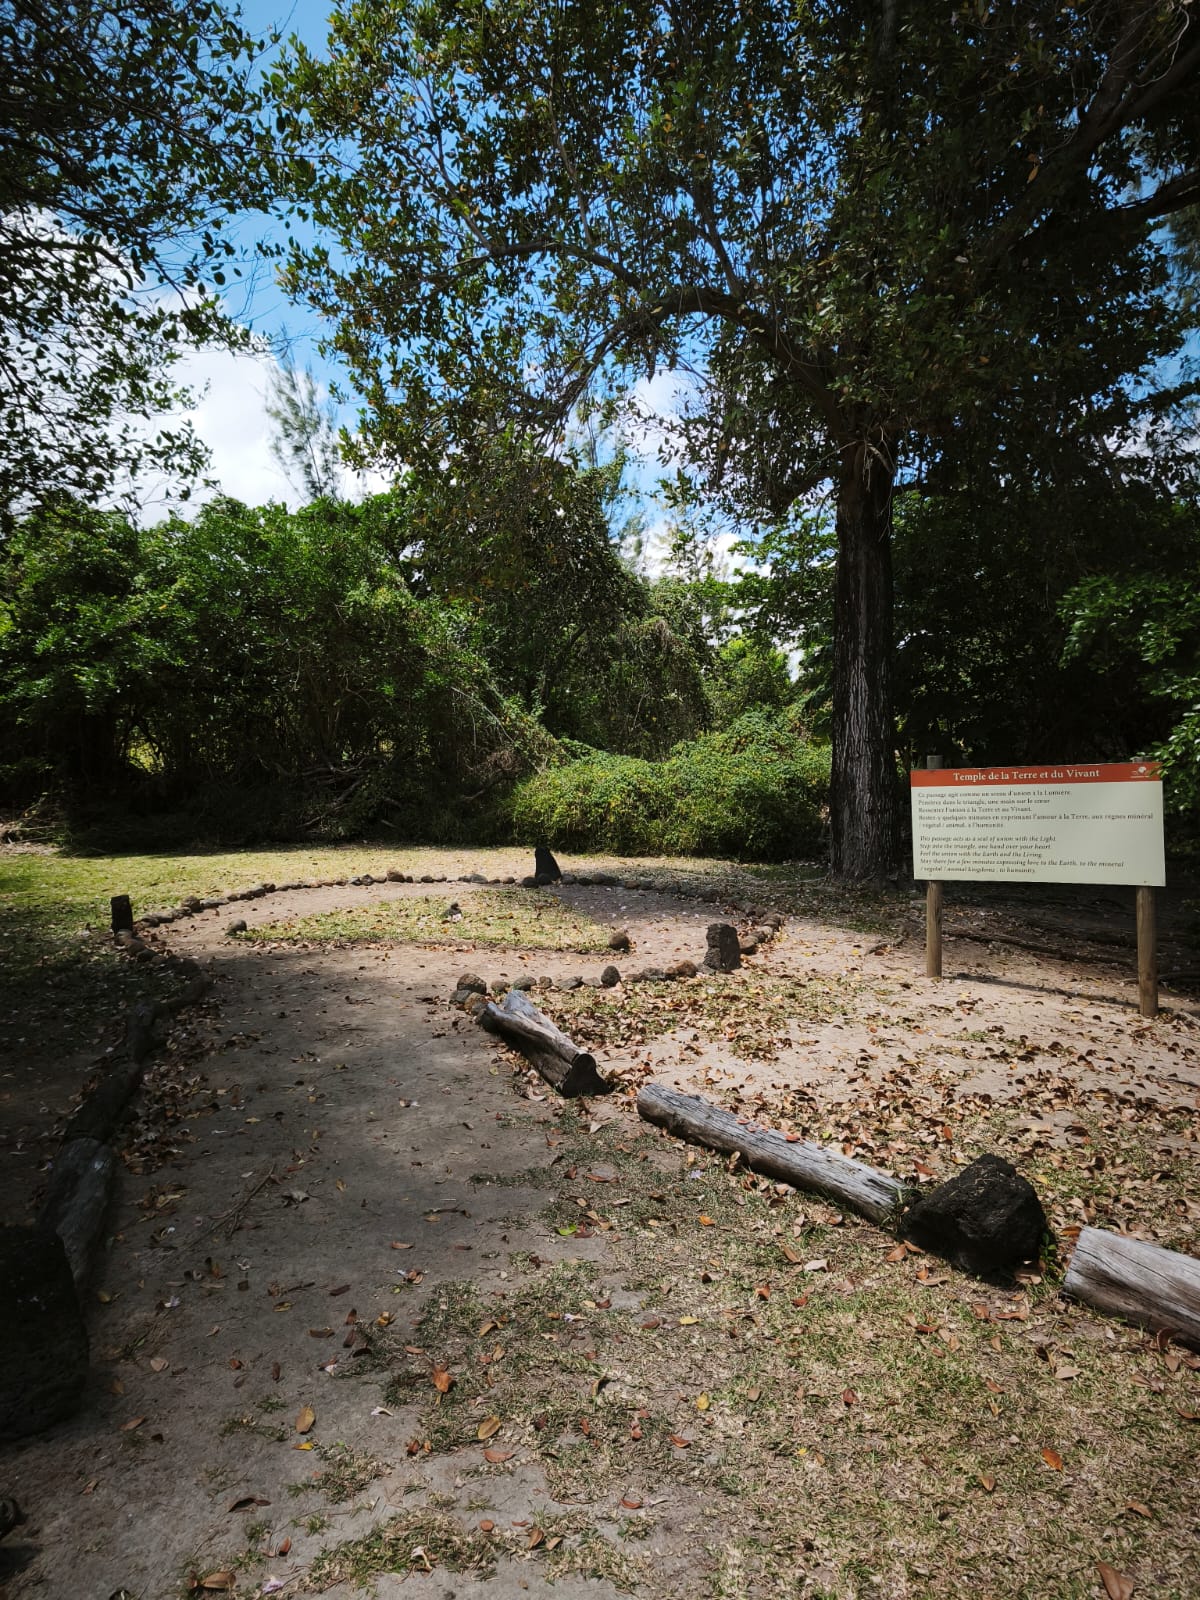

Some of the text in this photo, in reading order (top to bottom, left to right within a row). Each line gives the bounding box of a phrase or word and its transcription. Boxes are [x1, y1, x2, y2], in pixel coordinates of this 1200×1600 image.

[953, 772, 986, 782] Temple
[988, 772, 1000, 780] de
[1001, 772, 1009, 780] la
[1012, 772, 1037, 780] Terre
[1051, 770, 1064, 778] du
[1066, 769, 1100, 778] Vivant
